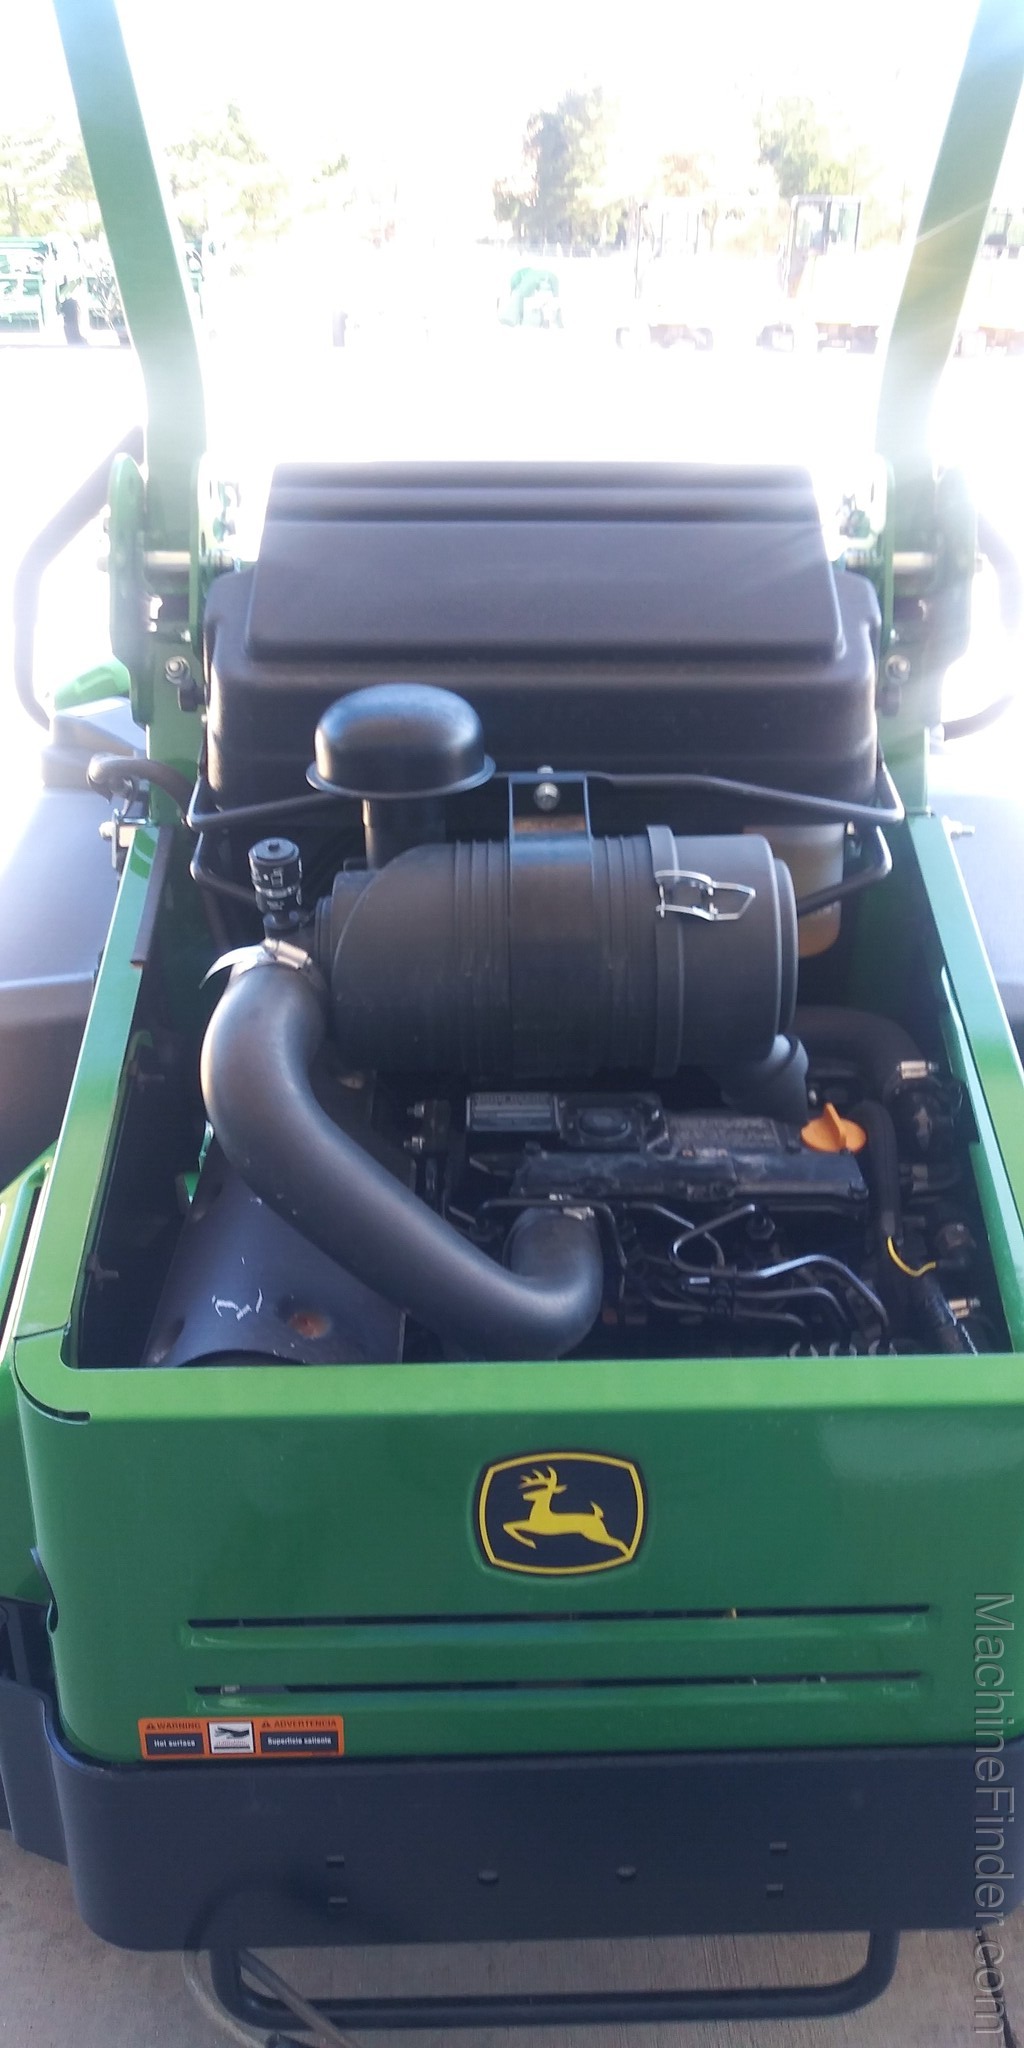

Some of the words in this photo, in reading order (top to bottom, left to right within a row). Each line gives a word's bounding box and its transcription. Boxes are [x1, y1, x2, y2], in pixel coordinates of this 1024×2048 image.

[156, 1721, 201, 1730] WARNING
[274, 1719, 337, 1728] ADVERTENCIA
[153, 1739, 167, 1748] Hot
[168, 1739, 196, 1748] surface
